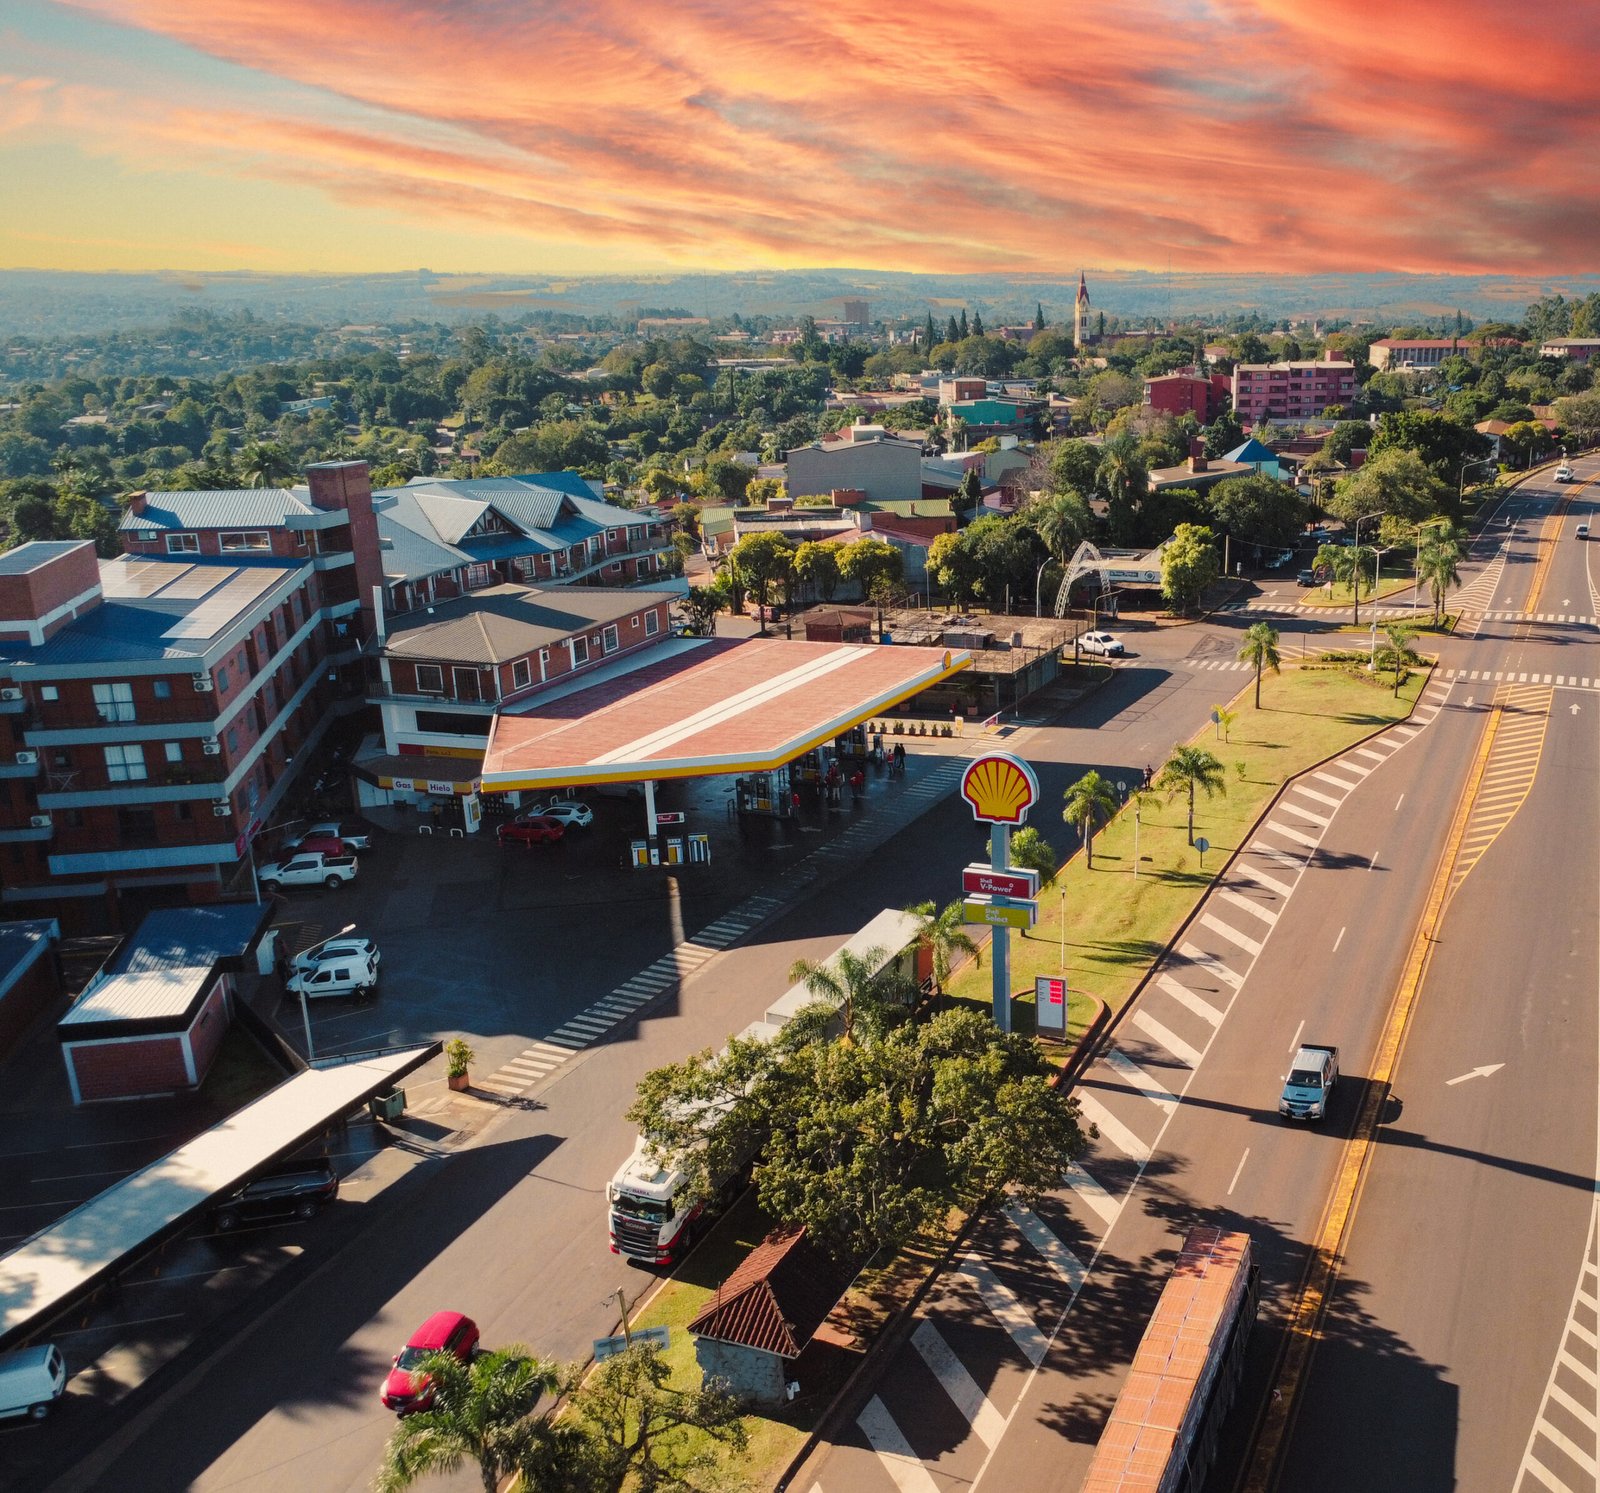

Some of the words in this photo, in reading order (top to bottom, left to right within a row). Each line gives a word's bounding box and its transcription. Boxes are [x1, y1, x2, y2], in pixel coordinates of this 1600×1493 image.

[395, 781, 411, 789] Gas
[430, 784, 451, 792] Hielo
[980, 883, 1012, 893] V-Power
[985, 914, 1008, 923] Select
